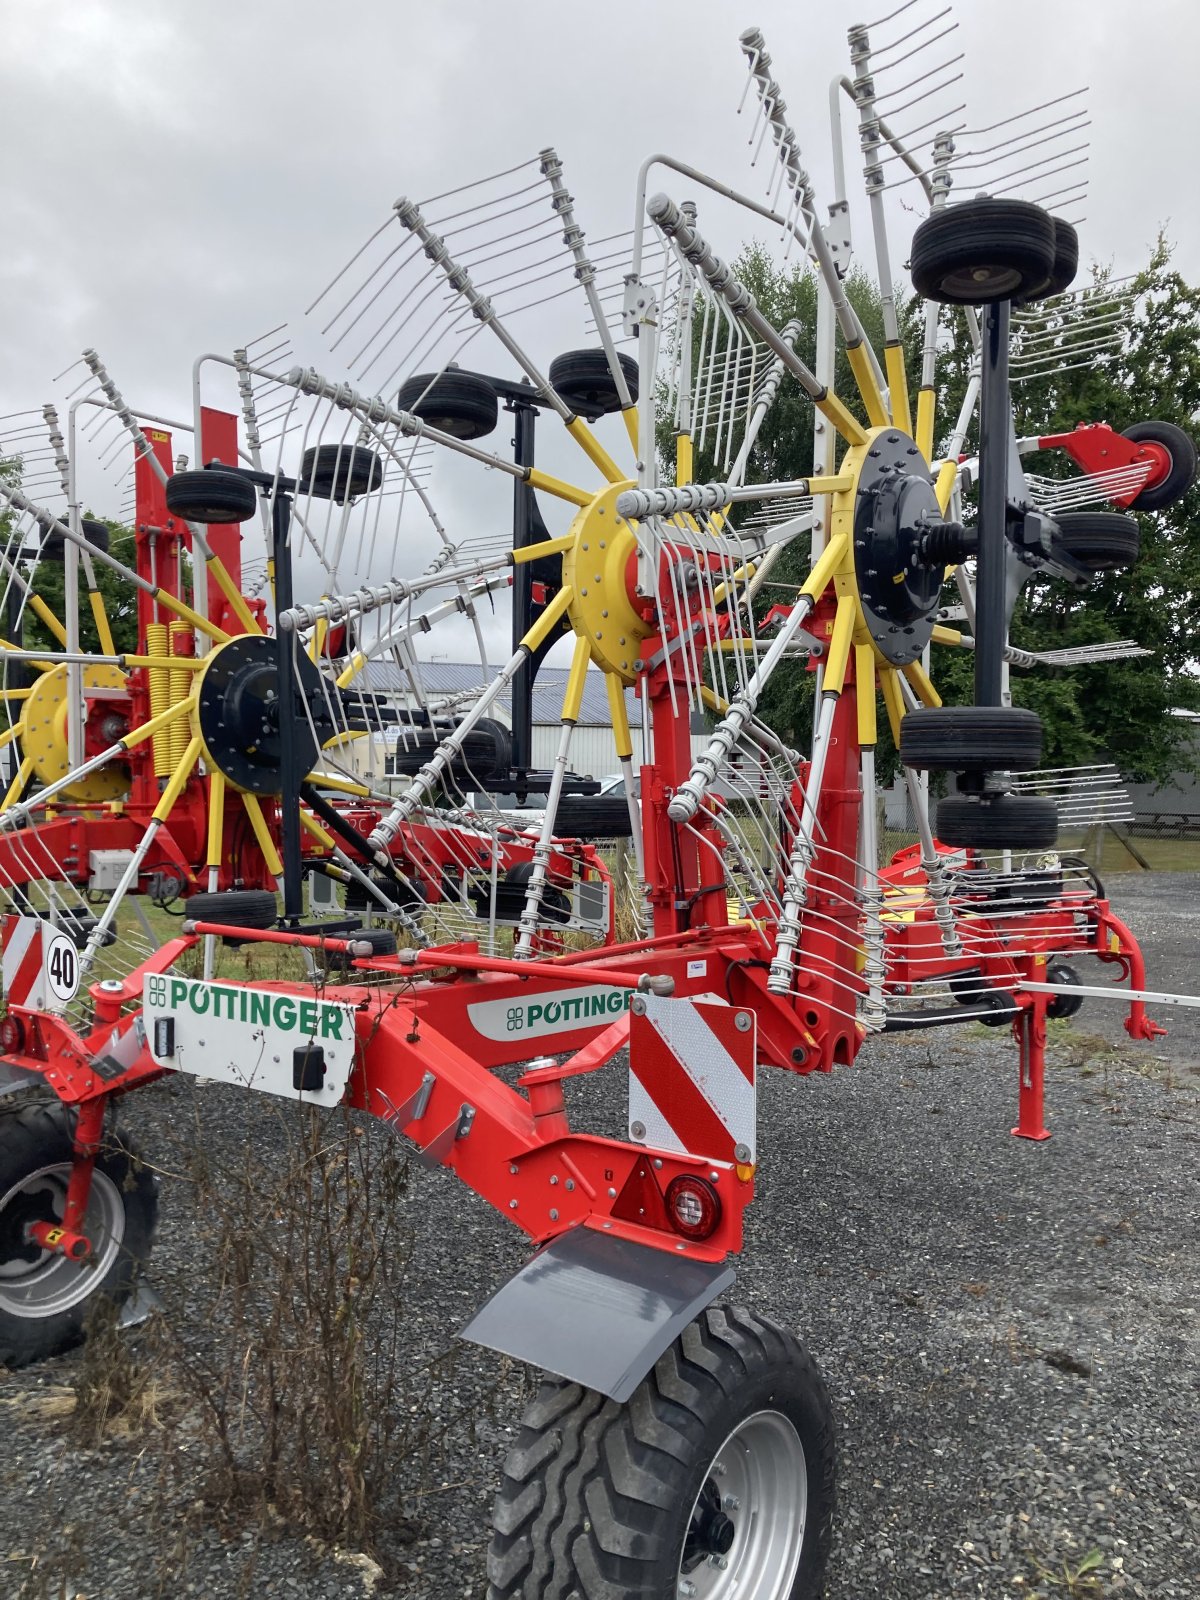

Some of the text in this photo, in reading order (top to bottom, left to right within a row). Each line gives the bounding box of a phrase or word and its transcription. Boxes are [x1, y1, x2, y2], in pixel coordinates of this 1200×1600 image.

[51, 947, 74, 989] 40
[171, 980, 343, 1041] PÖTTINGER
[527, 988, 649, 1027] PÖTTINGE
